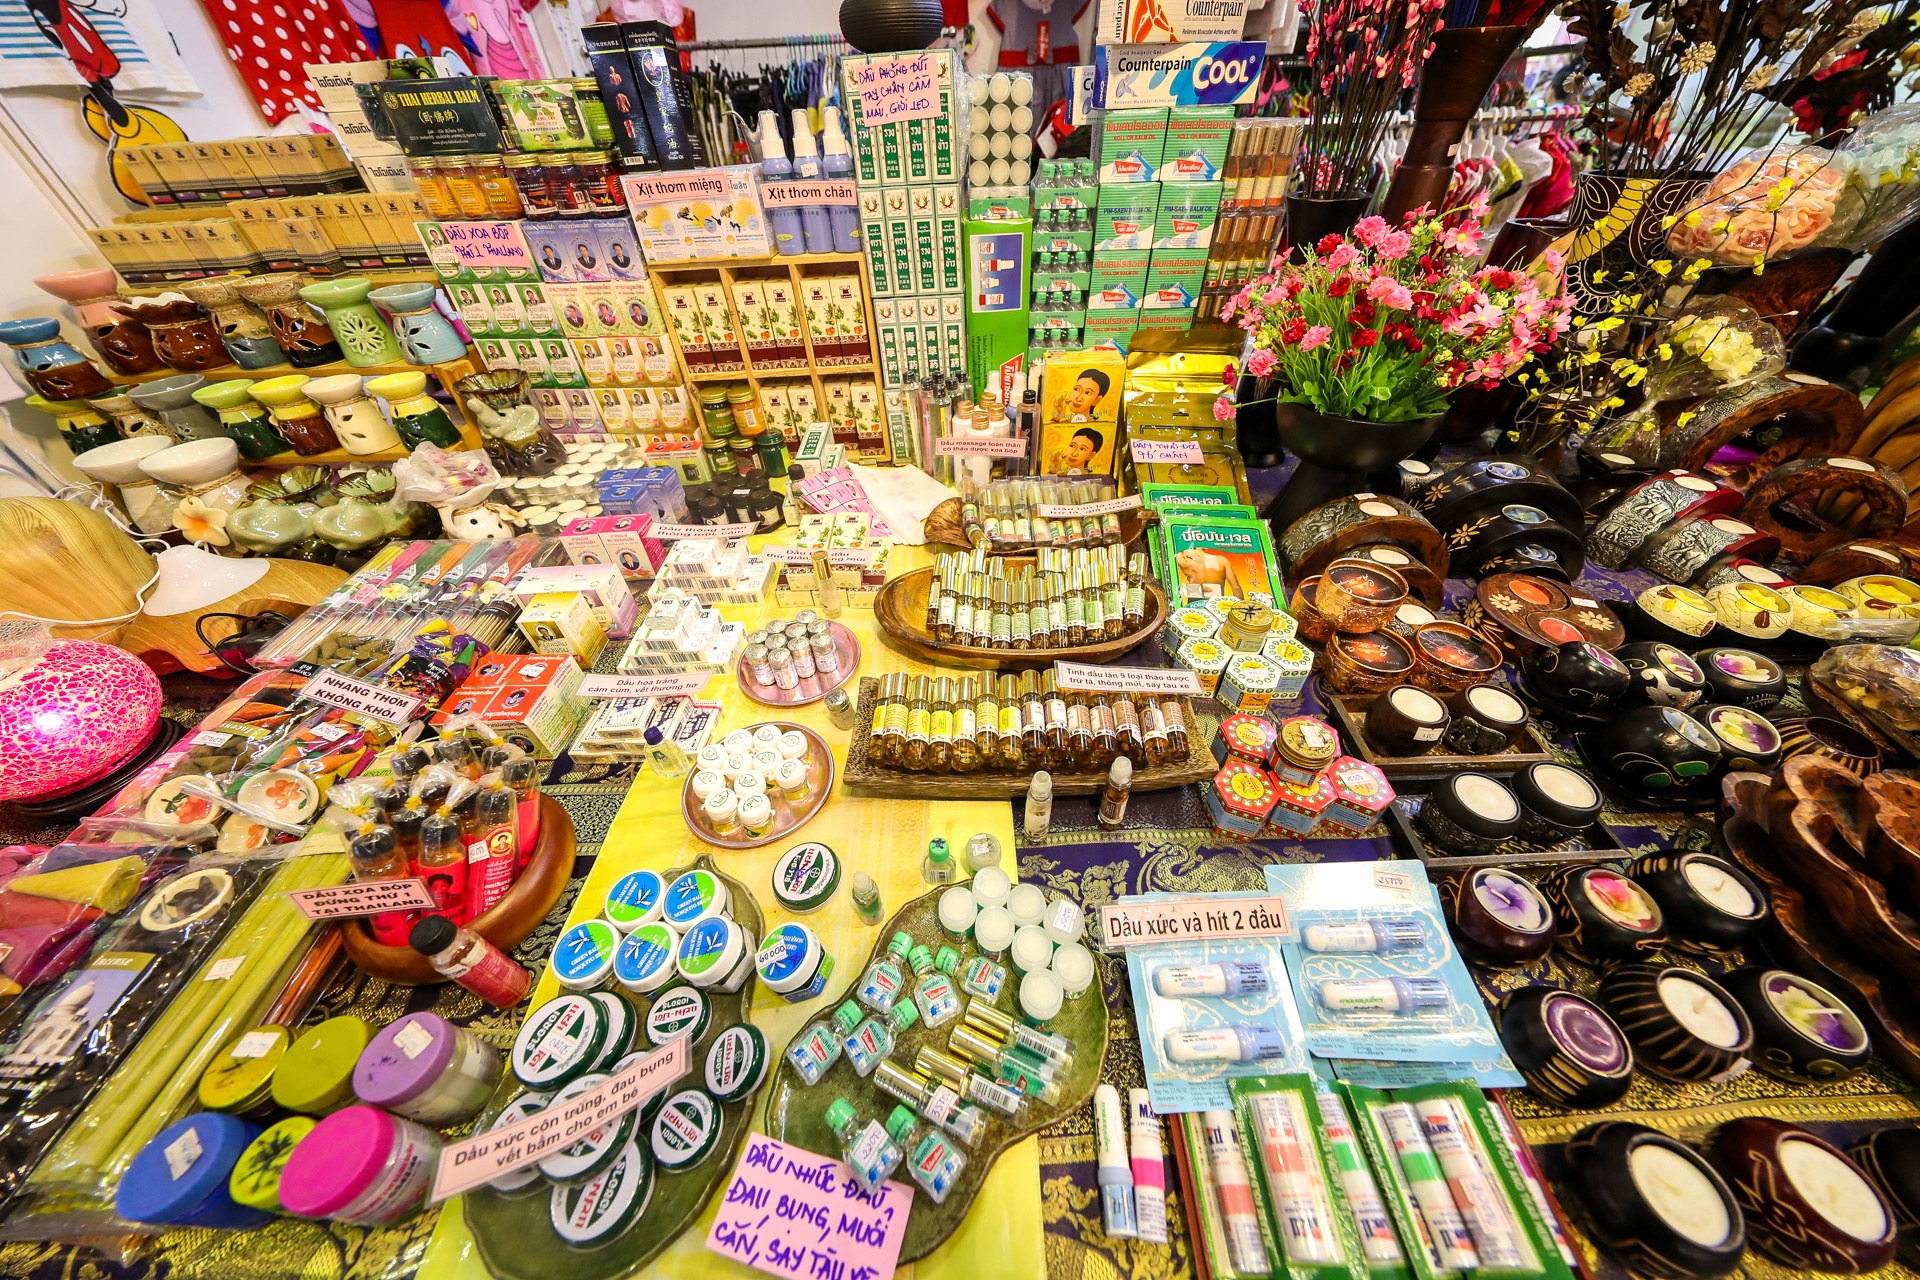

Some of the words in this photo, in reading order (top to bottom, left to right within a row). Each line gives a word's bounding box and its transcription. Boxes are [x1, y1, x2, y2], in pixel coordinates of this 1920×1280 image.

[1186, 0, 1243, 21] Counterpain
[1118, 56, 1192, 74] Counterpain
[1193, 55, 1249, 89] COOL
[397, 94, 420, 107] THAI
[421, 92, 455, 106] HERBAL
[454, 90, 480, 103] BALM
[636, 182, 653, 197] Xịt
[656, 180, 687, 194] thơm
[689, 178, 722, 196] miệng
[768, 188, 785, 202] Xịt
[789, 187, 821, 198] thơm
[825, 186, 852, 197] chân
[470, 225, 490, 239] XOA
[1066, 668, 1085, 676] Tinh
[1087, 670, 1103, 678] dầu
[1127, 672, 1143, 680] loại
[1098, 679, 1123, 687] thông
[324, 677, 371, 697] NHANG
[373, 691, 409, 707] THƠM
[651, 684, 683, 692] thương
[315, 689, 361, 708] KHÔNG
[363, 704, 396, 718] KHÓI
[303, 890, 337, 900] DẦU
[342, 886, 377, 897] XOA
[381, 883, 413, 892] BÓP
[314, 895, 360, 907] ĐỨNG
[365, 893, 398, 902] THỨ
[312, 905, 339, 916] TẠI
[344, 899, 424, 911] THAILAND
[674, 904, 696, 918] MOSQUITO
[695, 896, 712, 908] BRAND
[677, 899, 694, 909] GREEN
[1110, 911, 1143, 938] Dầu
[1147, 914, 1179, 936] xức
[1183, 912, 1203, 933] và
[1208, 907, 1230, 932] hít
[1233, 910, 1244, 930] 2
[1249, 901, 1282, 930] đầu
[91, 954, 134, 967] Incense
[569, 956, 596, 975] MOSQUITO
[595, 946, 612, 959] BRAND
[571, 954, 589, 966] GREEN
[637, 952, 650, 969] GREEN
[639, 951, 657, 976] MOSQUITO
[654, 936, 668, 955] BRAND
[454, 1142, 488, 1167] Dầu
[493, 1130, 525, 1152] xức
[529, 1119, 560, 1141] côn
[611, 1075, 635, 1095] đau
[640, 1051, 674, 1080] bụng
[496, 1149, 522, 1168] vết
[527, 1131, 562, 1156] bầm
[565, 1118, 593, 1137] cho
[597, 1103, 617, 1120] em
[621, 1085, 639, 1103] bé
[726, 1176, 771, 1209] ĐAU
[766, 1238, 805, 1272] SAY
